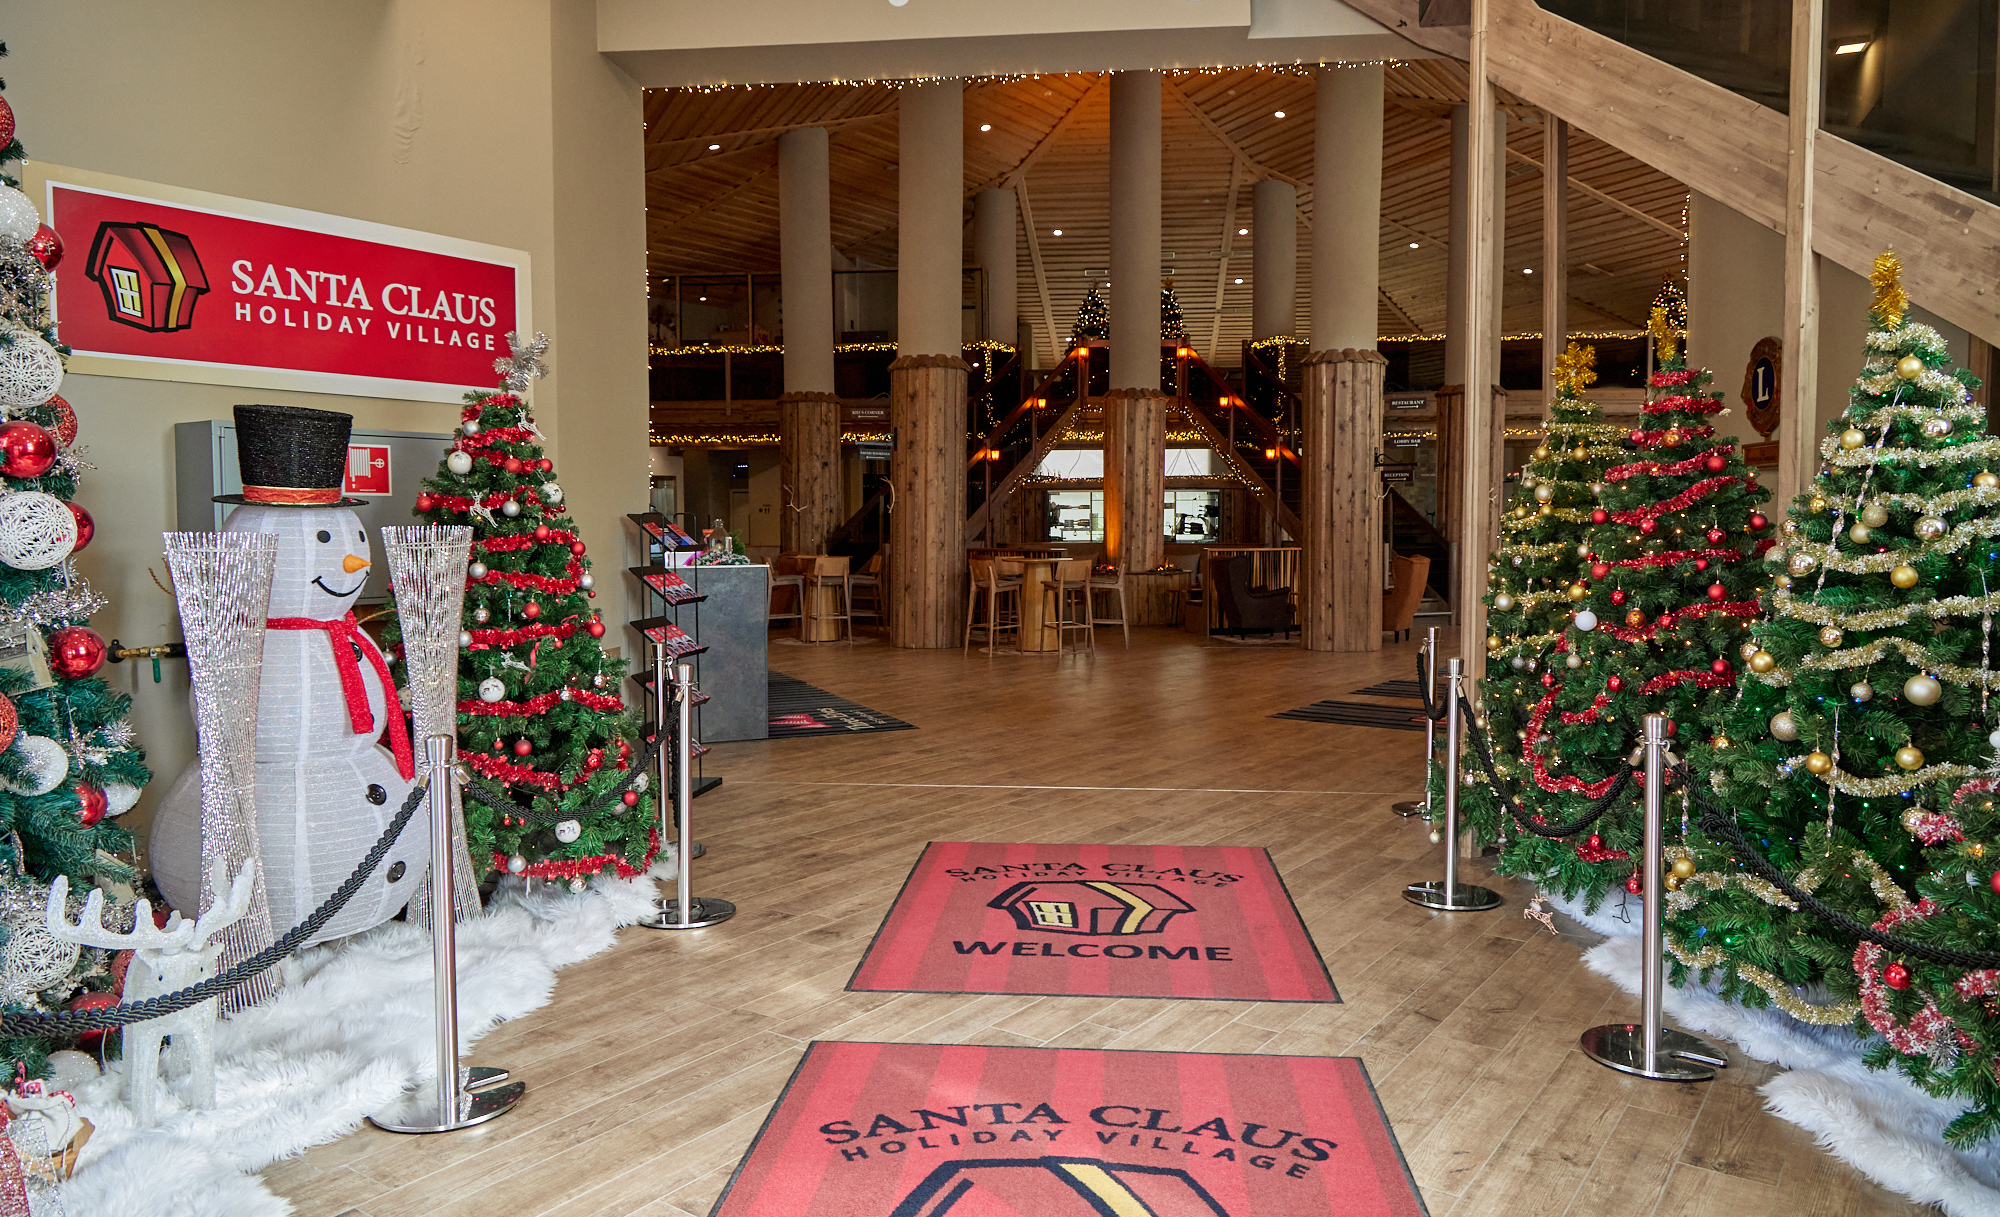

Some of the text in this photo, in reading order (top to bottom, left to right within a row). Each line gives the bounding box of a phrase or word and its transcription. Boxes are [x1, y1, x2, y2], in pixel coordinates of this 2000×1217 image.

[231, 259, 496, 327] SANTA CLAUS
[235, 302, 495, 351] HOLIDAY VILLAGE
[1756, 367, 1769, 402] L
[945, 862, 1245, 883] SANTA CLAUS
[960, 871, 1229, 888] HOLIDAY VILLAGE
[952, 940, 1234, 961] WELCOME
[818, 1102, 1340, 1163] SANTA CLAUS
[841, 1129, 1313, 1180] HOLIDAY VILLAGE
